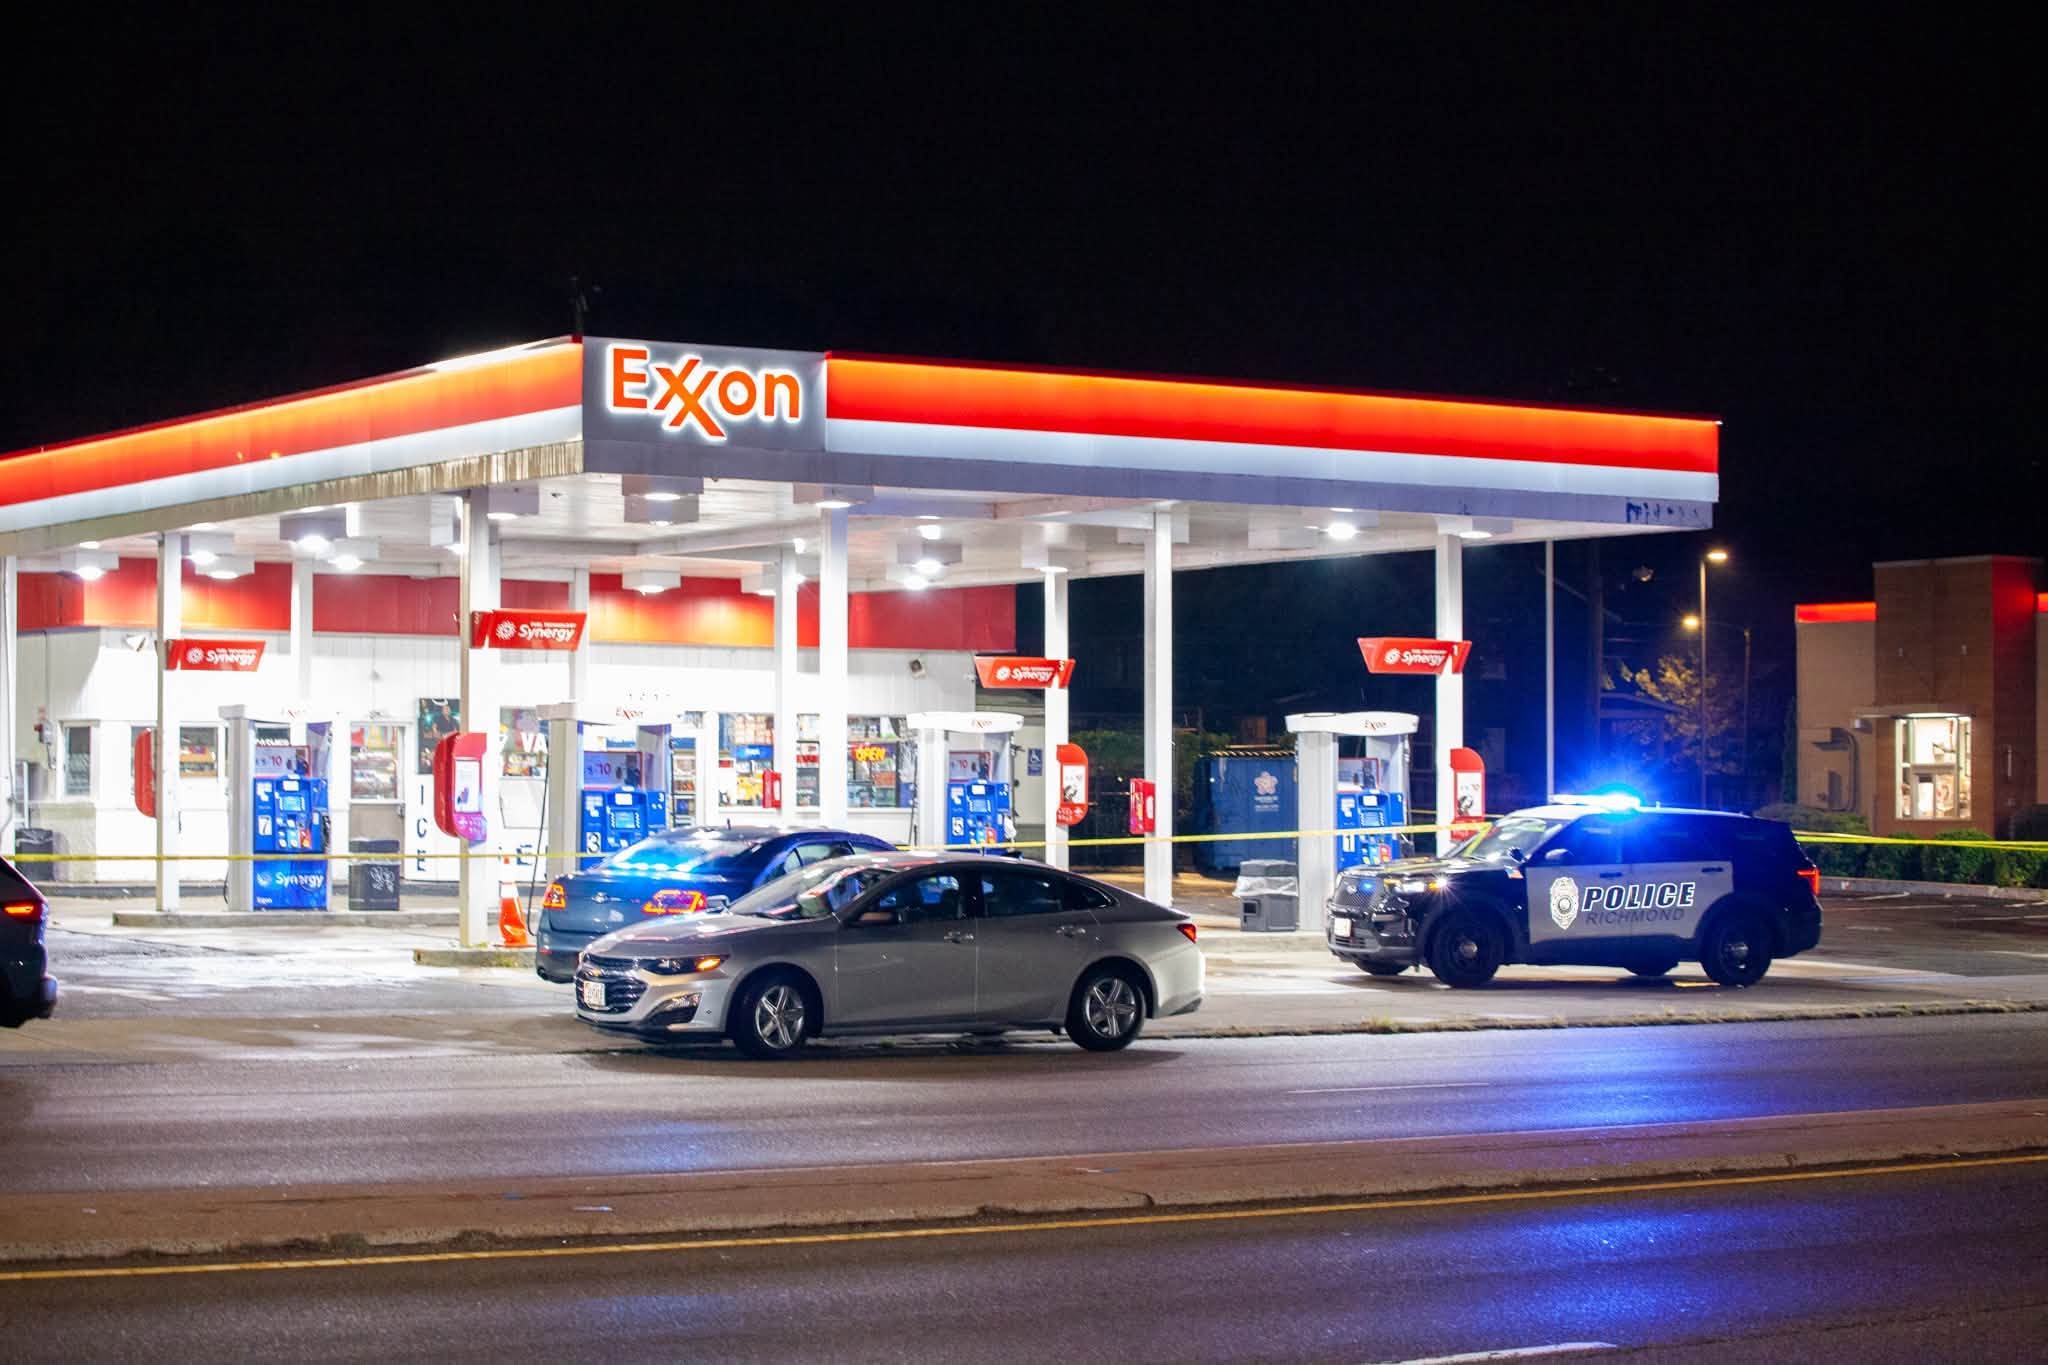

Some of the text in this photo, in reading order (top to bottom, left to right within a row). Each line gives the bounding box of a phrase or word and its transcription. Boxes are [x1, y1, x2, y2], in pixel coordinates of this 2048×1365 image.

[609, 344, 801, 439] Exxon
[518, 624, 576, 642] Synergy
[206, 649, 257, 666] Synergy
[1401, 651, 1446, 666] Synergy
[1012, 667, 1053, 682] Synergy
[855, 746, 886, 762] OPEN
[260, 816, 270, 834] 7
[953, 818, 963, 834] 5
[588, 832, 600, 853] 3
[275, 871, 325, 888] Synergy
[1581, 882, 1696, 912] POLICE
[1585, 908, 1686, 926] RICHMOND
